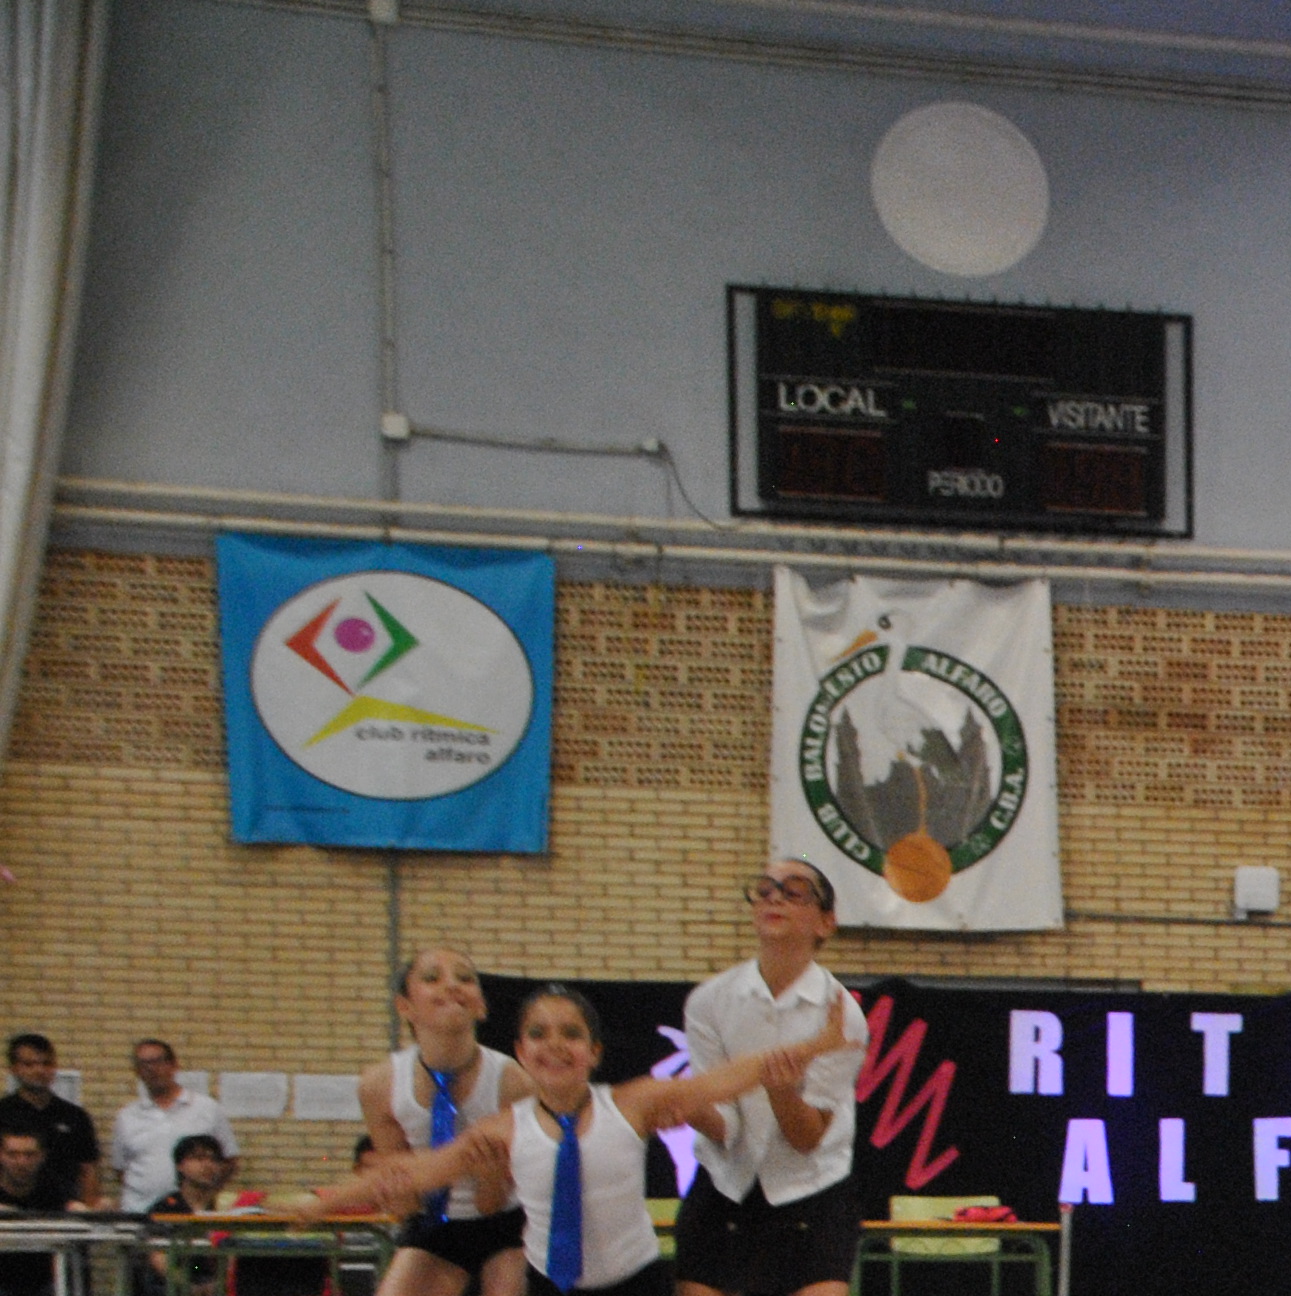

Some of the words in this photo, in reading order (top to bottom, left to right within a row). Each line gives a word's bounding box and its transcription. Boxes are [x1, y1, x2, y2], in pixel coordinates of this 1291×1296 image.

[777, 383, 887, 418] LOCAL
[1047, 402, 1151, 434] VISITANTE
[927, 468, 1005, 499] PERIODO
[922, 653, 1008, 719] ALFARO
[355, 725, 405, 742] club
[424, 746, 492, 765] alfaro
[801, 801, 871, 861] CLUB
